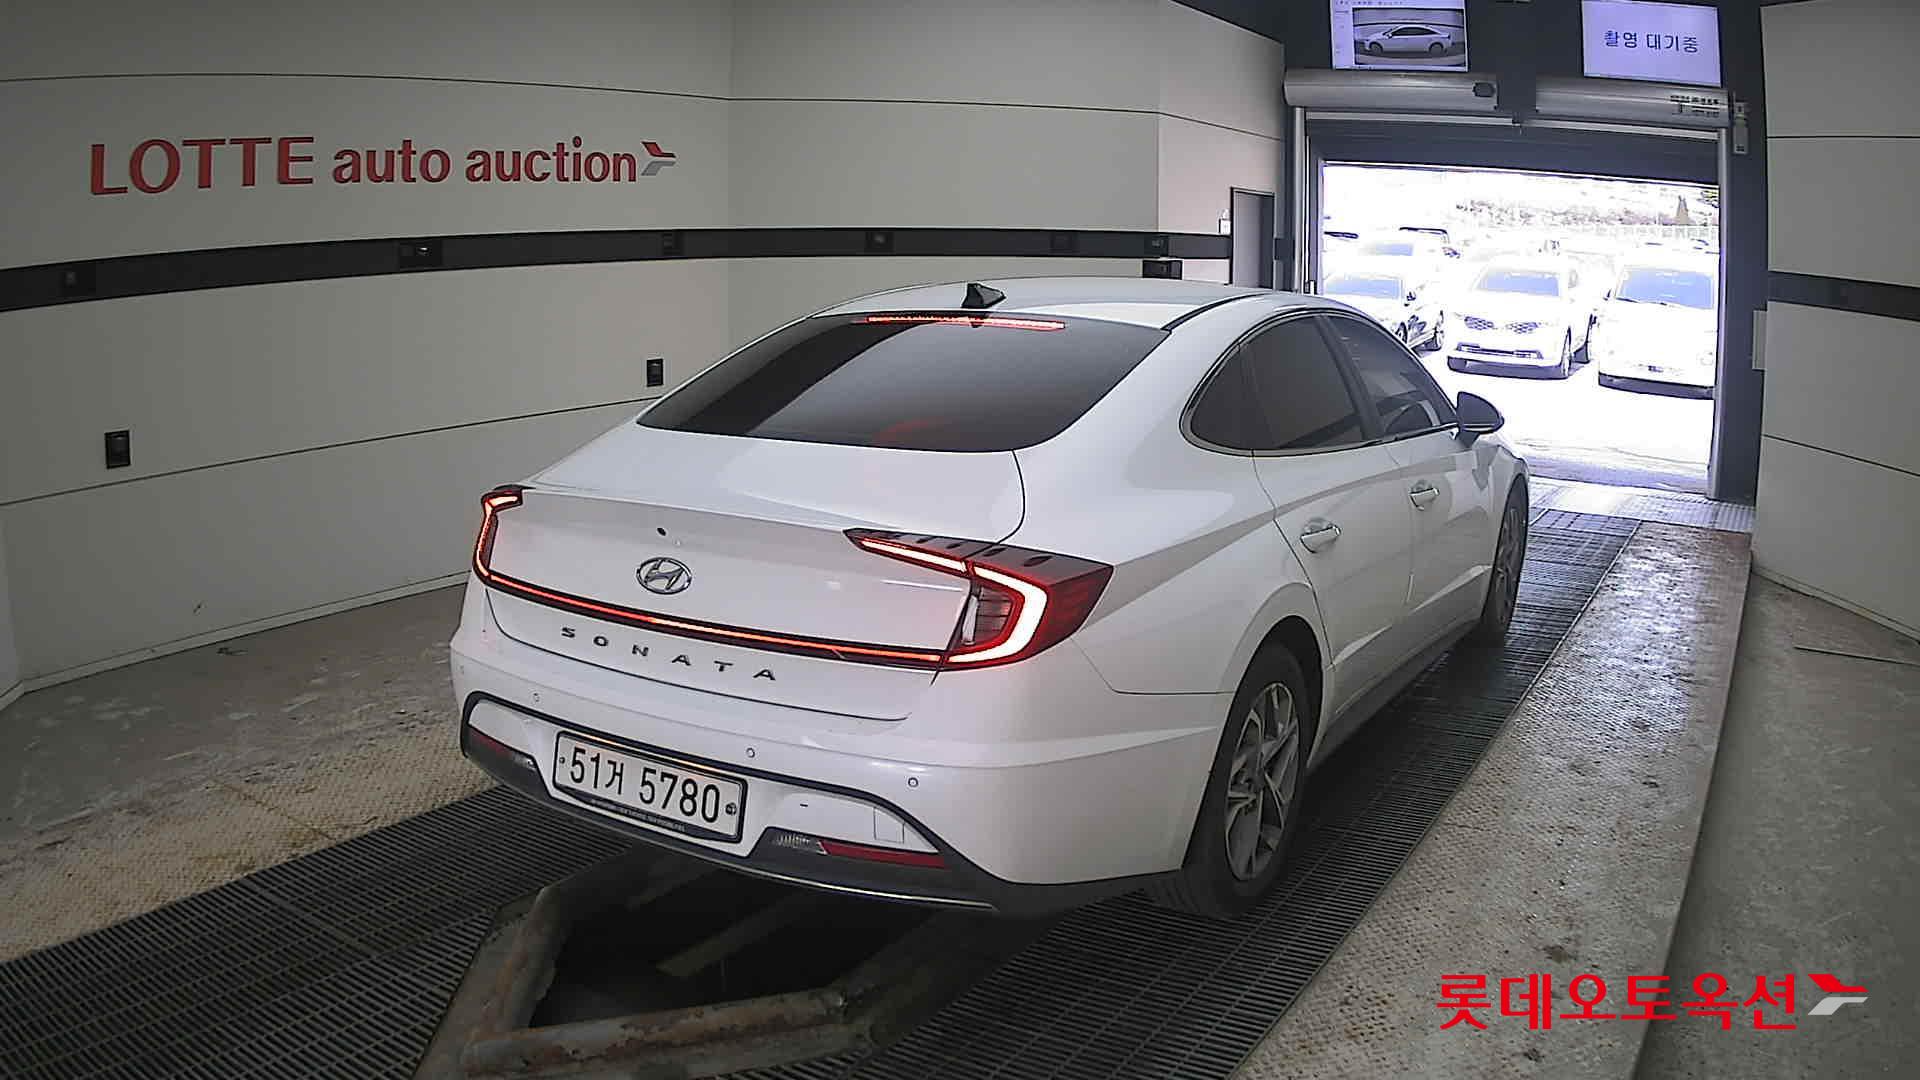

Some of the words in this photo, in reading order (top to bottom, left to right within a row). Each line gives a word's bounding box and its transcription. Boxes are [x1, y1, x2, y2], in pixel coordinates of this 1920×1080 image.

[1604, 30, 1638, 48] 촬영
[1646, 33, 1699, 53] 대기중
[91, 136, 315, 195] LOTTE
[332, 139, 451, 184] auto
[465, 136, 638, 184] auction
[561, 627, 776, 681] SONATA
[570, 746, 624, 795] 51거
[639, 766, 720, 823] 5780
